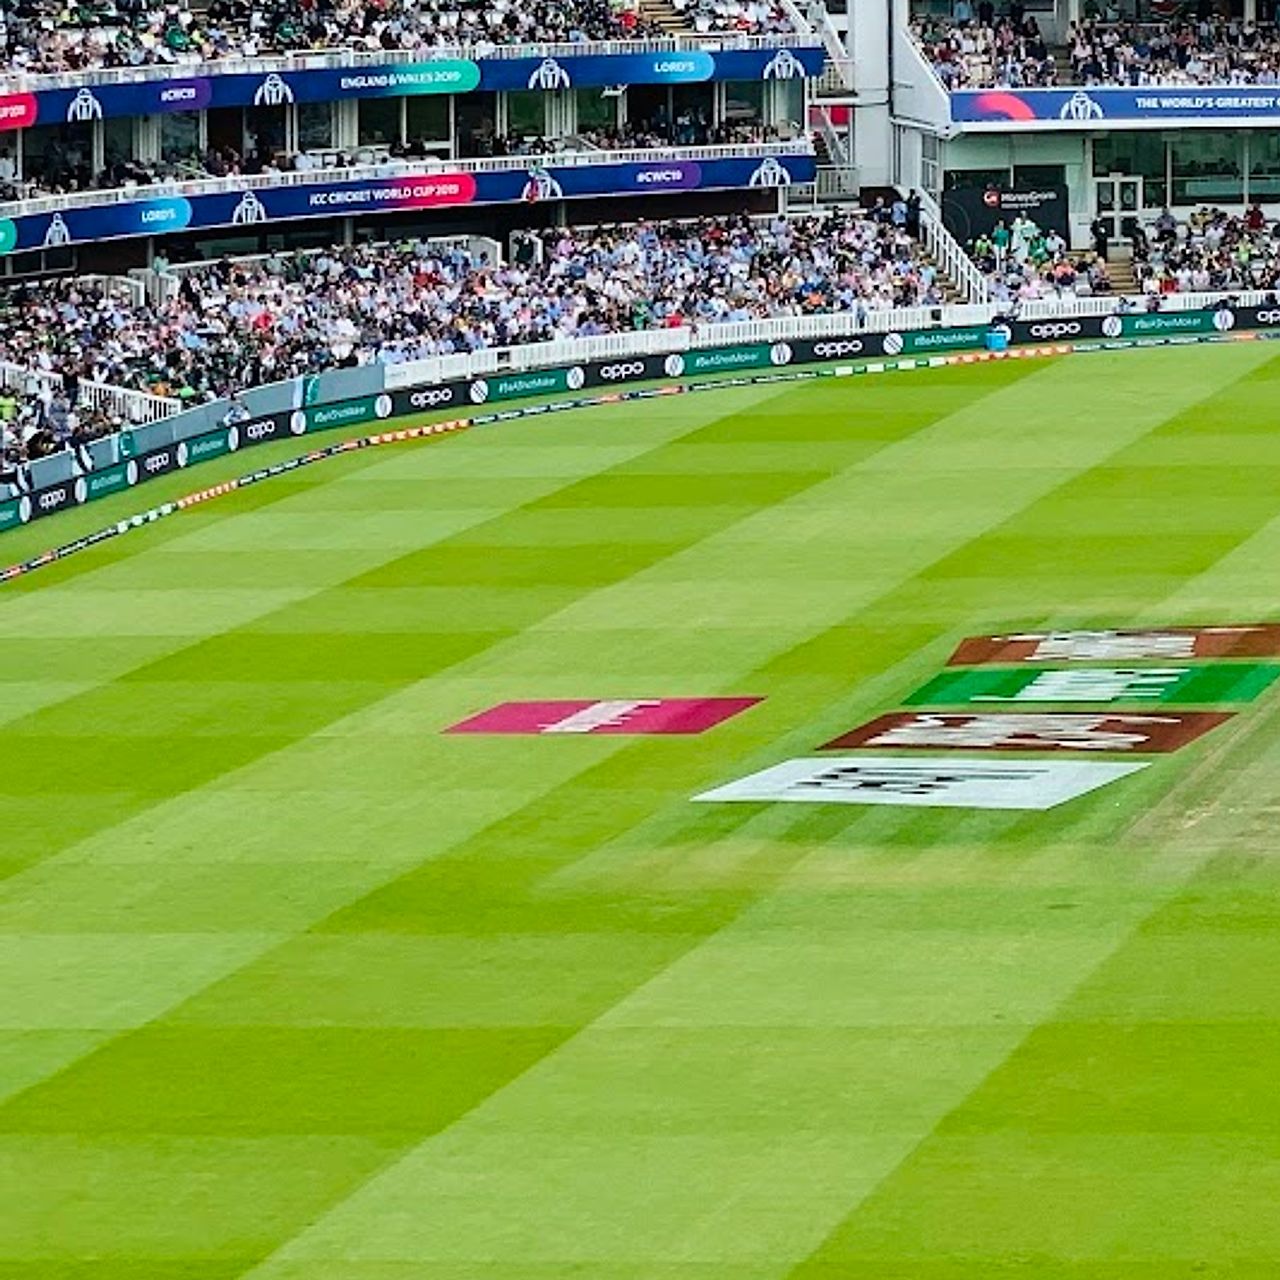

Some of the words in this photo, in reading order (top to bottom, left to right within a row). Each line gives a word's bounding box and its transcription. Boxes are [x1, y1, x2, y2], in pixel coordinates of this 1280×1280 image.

[654, 61, 695, 72] LORD'S
[1136, 97, 1158, 108] THE
[1160, 97, 1213, 108] WORLD'S
[1216, 97, 1274, 108] GREATEST
[310, 193, 328, 205] ICC
[328, 191, 370, 204] CRICKET
[374, 187, 411, 200] WORLD
[413, 186, 434, 197] CUP
[1030, 321, 1081, 338] oppo
[814, 340, 862, 357] oppo
[600, 361, 644, 380] oppo
[410, 388, 452, 408] oppo
[247, 421, 275, 439] oppo
[145, 453, 169, 472] oppo
[39, 488, 66, 509] oppo
